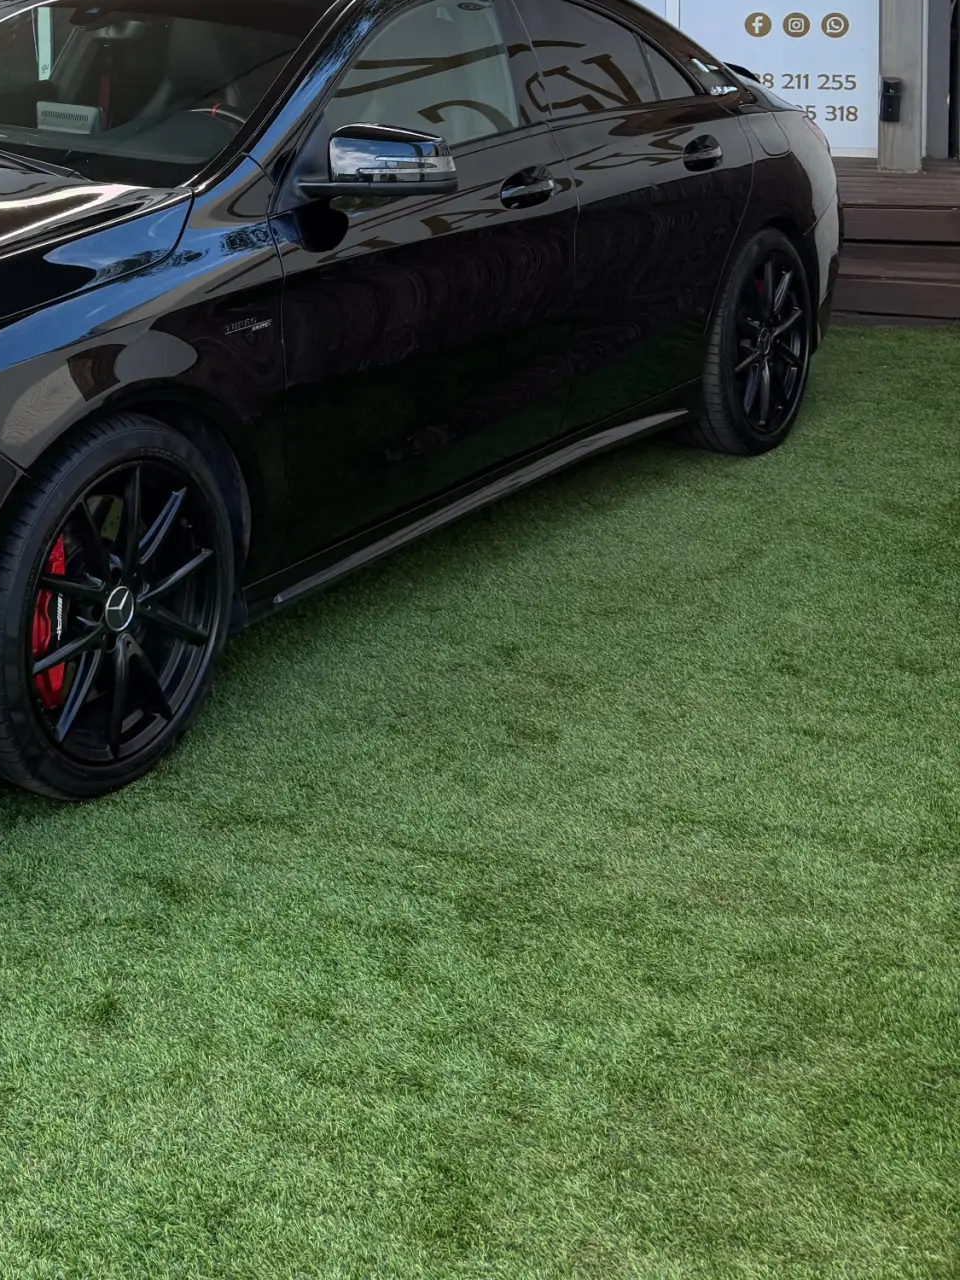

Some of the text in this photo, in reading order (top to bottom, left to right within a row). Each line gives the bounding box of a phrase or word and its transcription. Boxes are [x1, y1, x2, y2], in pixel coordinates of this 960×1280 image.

[781, 73, 810, 90] 211
[817, 74, 857, 91] 255
[825, 106, 858, 122] 318
